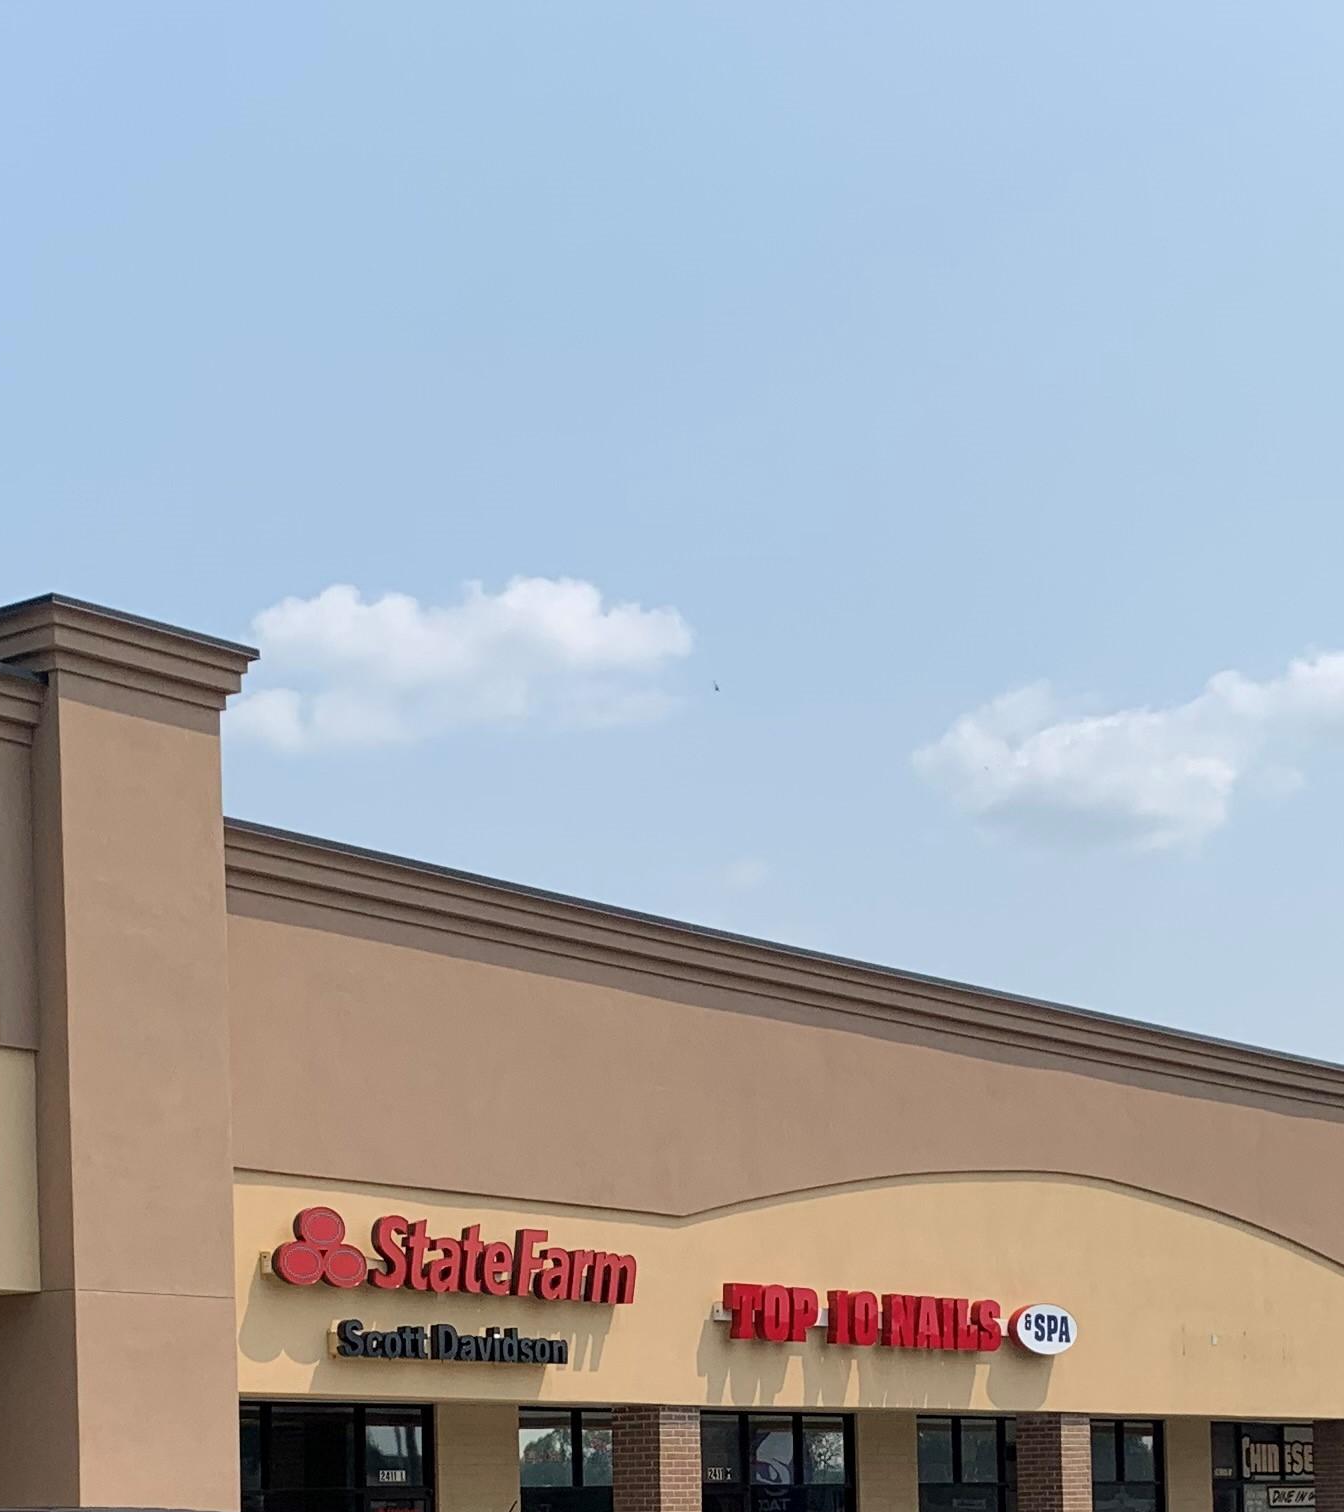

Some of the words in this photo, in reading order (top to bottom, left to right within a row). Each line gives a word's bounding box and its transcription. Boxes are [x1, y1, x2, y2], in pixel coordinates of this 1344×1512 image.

[337, 1319, 429, 1359] Scott
[430, 1324, 568, 1364] Davidson
[723, 1283, 818, 1342] TOP
[827, 1290, 877, 1346] 10
[881, 1293, 1001, 1351] NAILS
